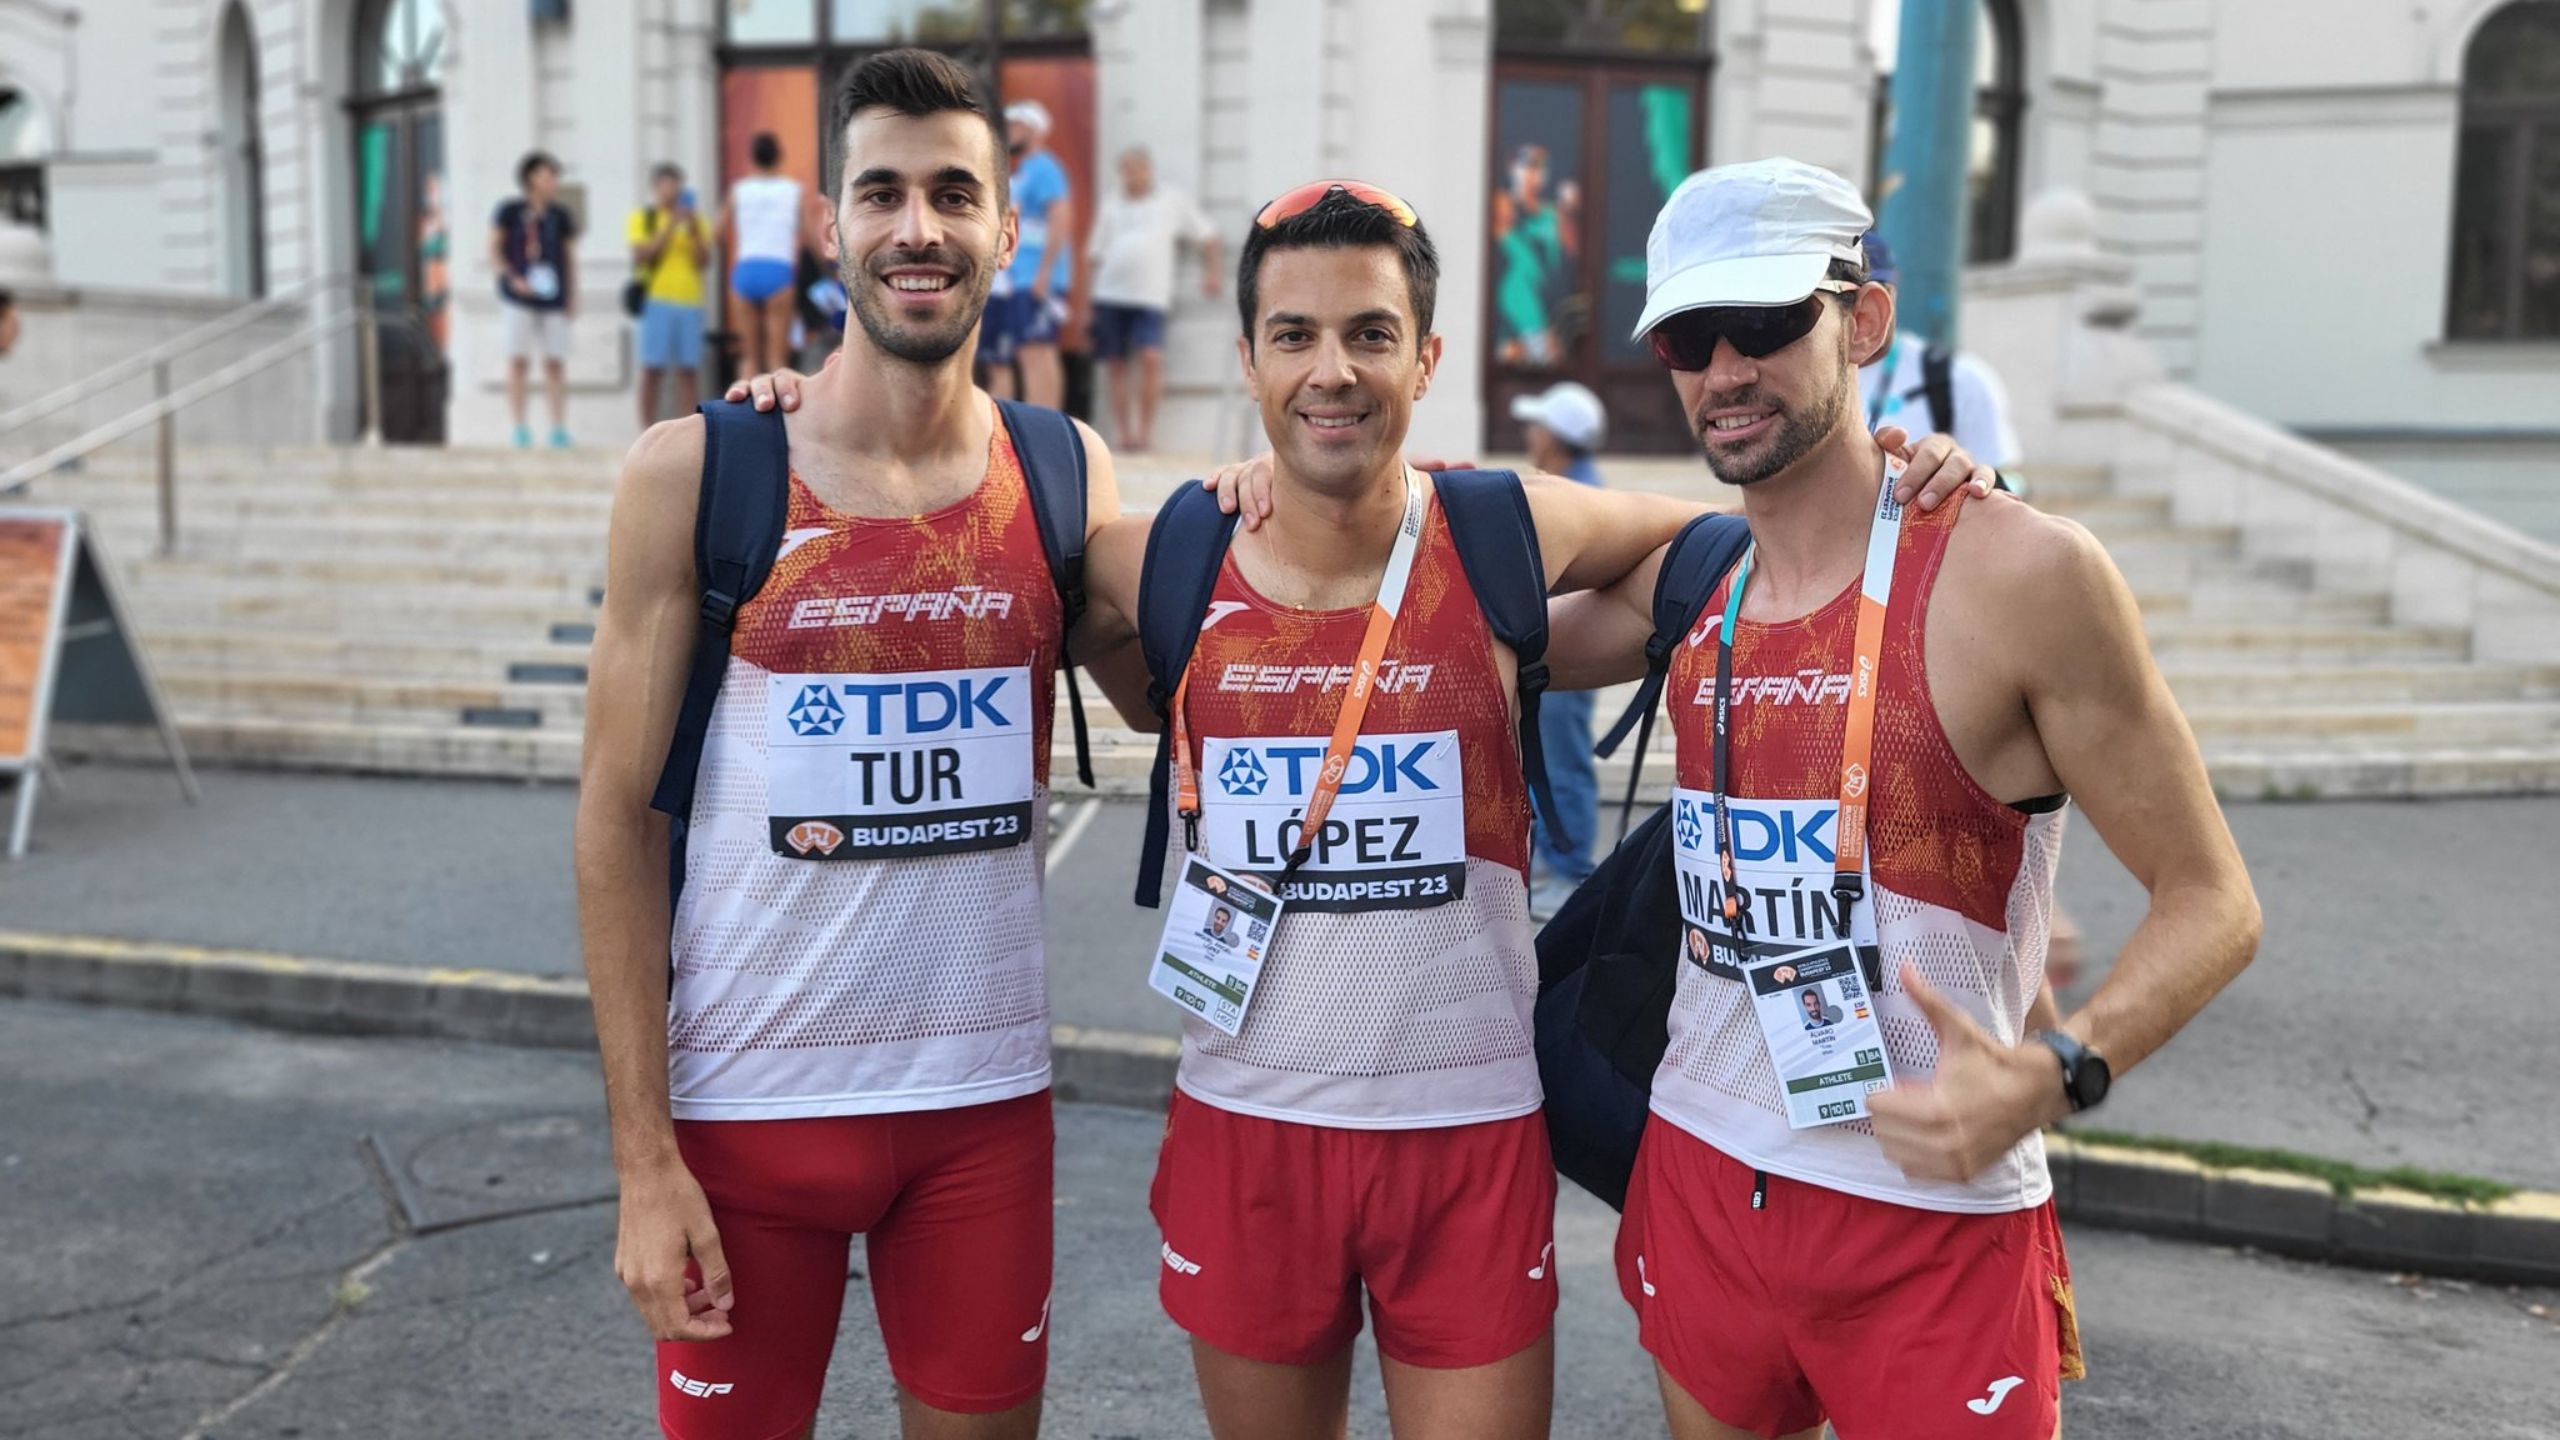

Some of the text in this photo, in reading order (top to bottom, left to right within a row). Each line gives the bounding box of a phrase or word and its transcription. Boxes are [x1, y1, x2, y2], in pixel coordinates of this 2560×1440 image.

[788, 585, 1014, 629] ESPAÑA
[844, 676, 1012, 735] TDK
[851, 747, 963, 806] TUR
[1266, 741, 1440, 795] TDK
[853, 815, 1019, 847] BUDAPEST 23
[1245, 808, 1422, 864] LÓPEZ
[1701, 801, 1838, 863] TDK
[1281, 879, 1415, 900] BUDAPEST
[1418, 874, 1449, 896] 23
[1682, 870, 1846, 940] MARTÍN
[1187, 969, 1217, 990] ATHLETE
[1221, 1001, 1236, 1015] STA
[1819, 1072, 1853, 1086] ATHLETE
[1867, 1081, 1885, 1092] STA
[669, 1369, 734, 1398] ESP
